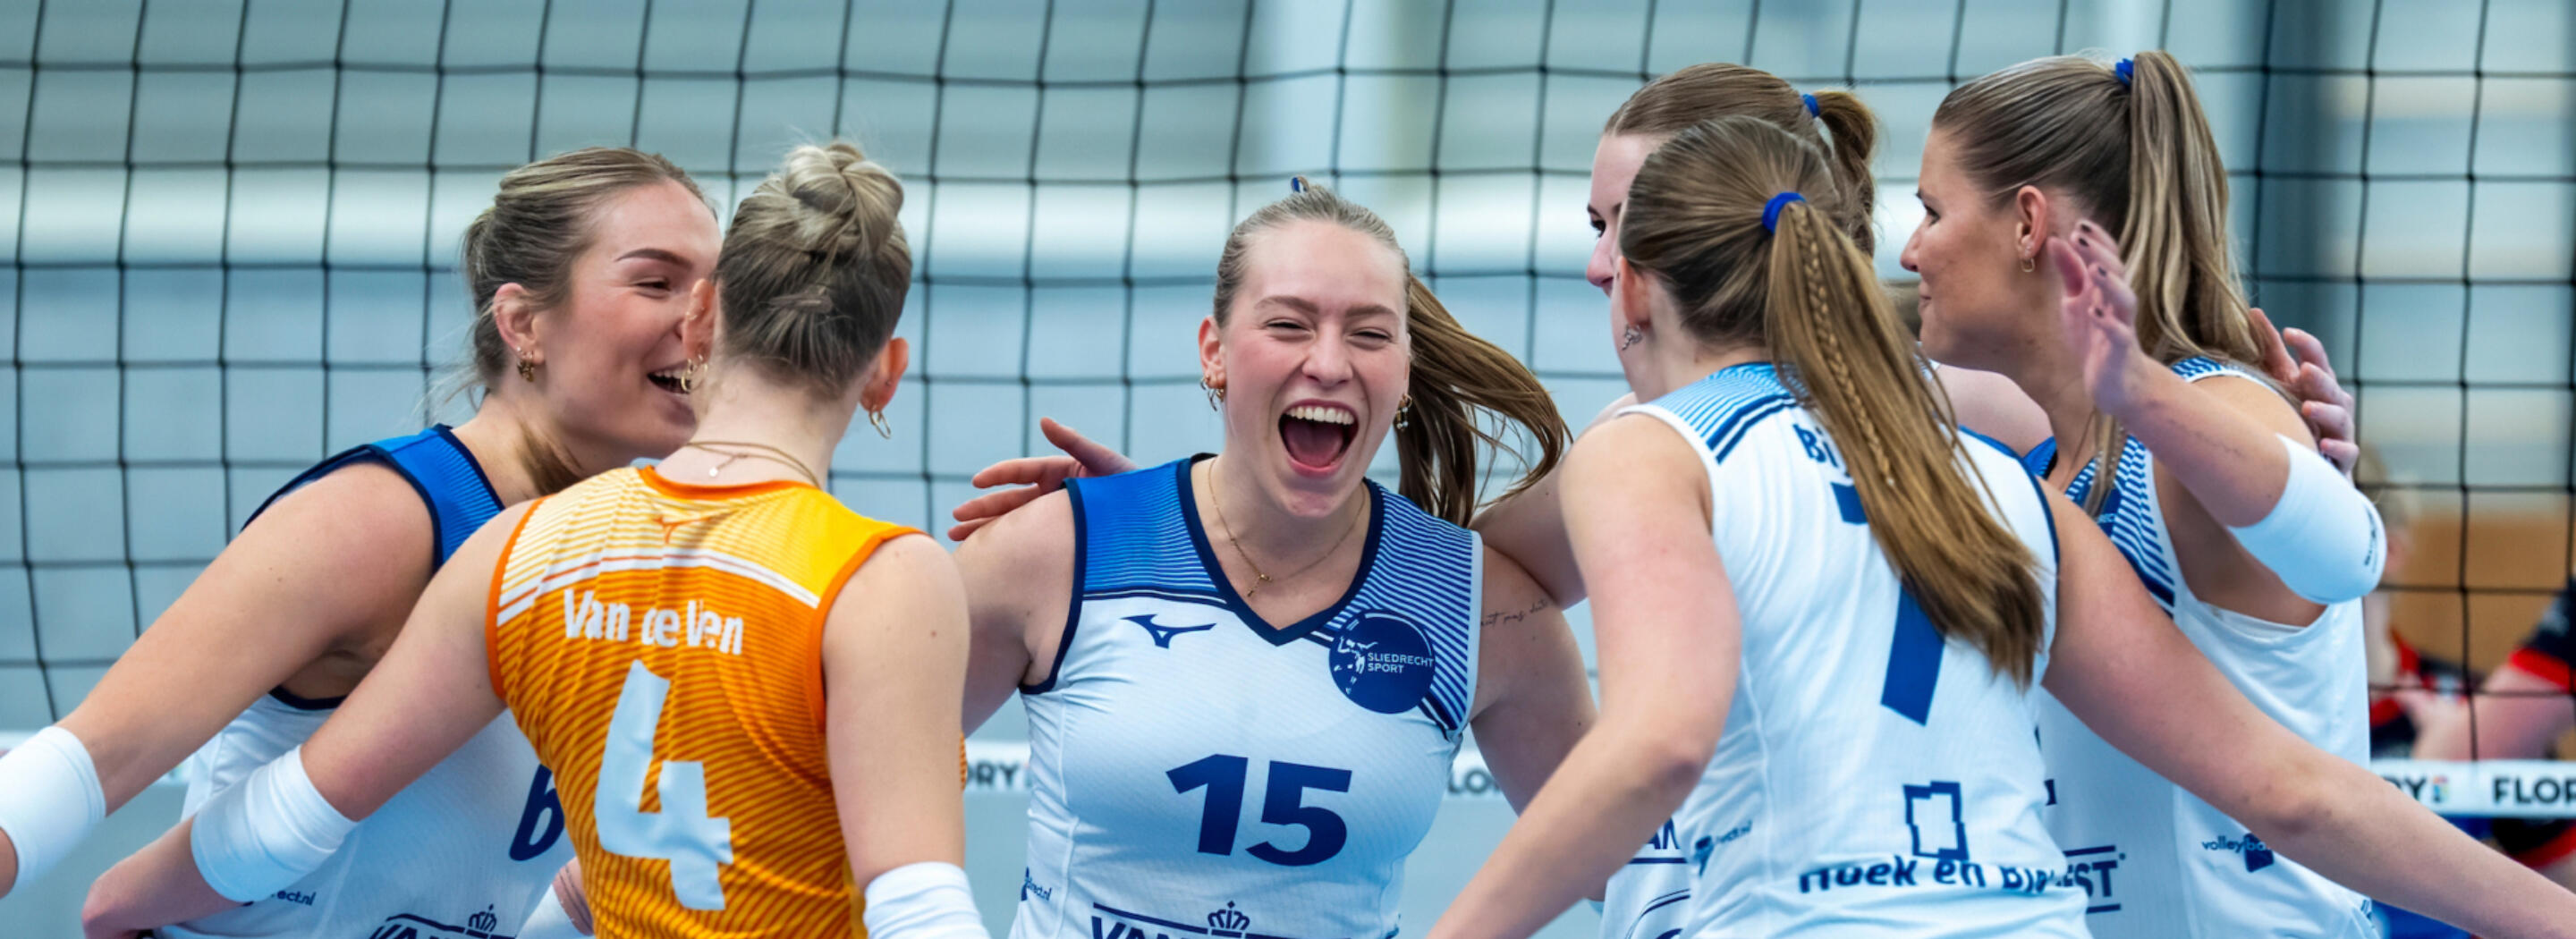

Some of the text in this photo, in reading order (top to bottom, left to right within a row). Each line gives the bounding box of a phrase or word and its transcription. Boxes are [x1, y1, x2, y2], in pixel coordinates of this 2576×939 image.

[1792, 423, 1851, 478] Bi
[563, 588, 631, 642] Van
[1830, 480, 1946, 726] 7
[1367, 652, 1435, 667] SLIEDRECHT
[1367, 663, 1404, 673] SPORT
[593, 658, 733, 910] 4
[1165, 753, 1352, 867] 15
[1933, 858, 1986, 888] en
